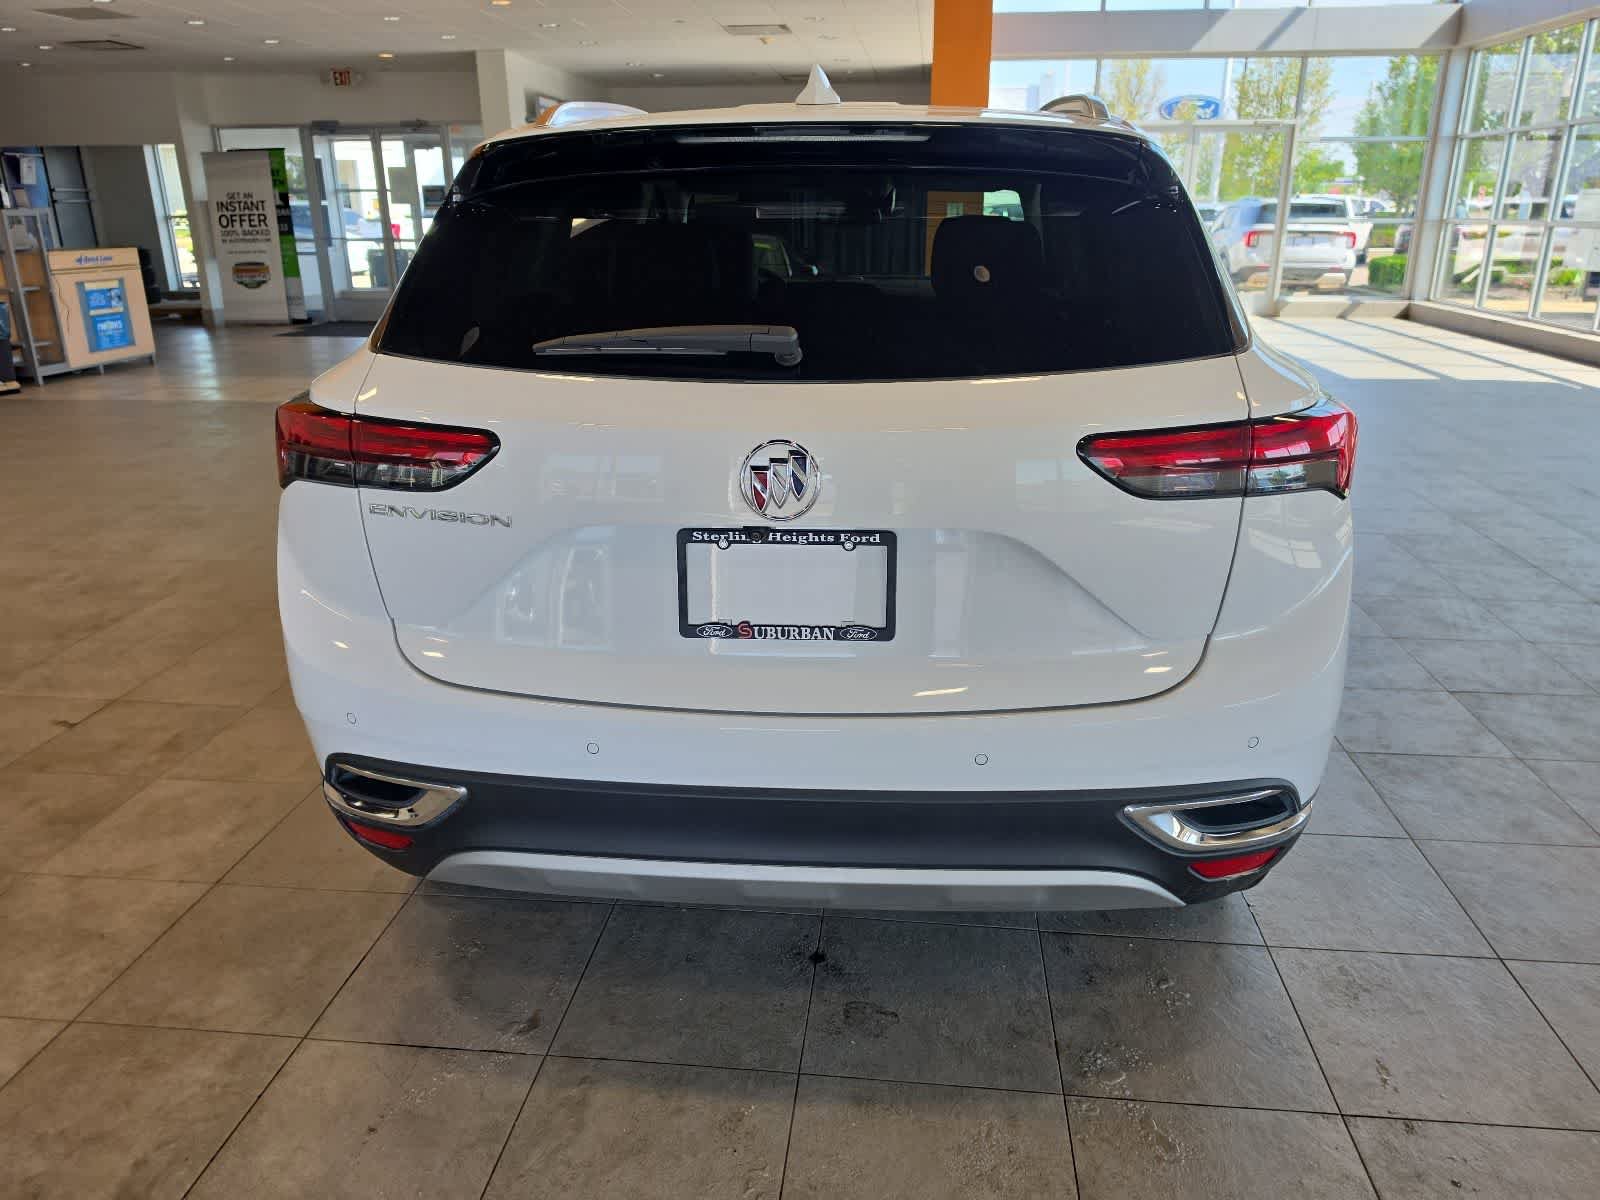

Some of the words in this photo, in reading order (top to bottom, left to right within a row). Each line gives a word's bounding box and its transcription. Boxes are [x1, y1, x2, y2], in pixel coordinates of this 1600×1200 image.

[332, 70, 351, 87] EXIT
[216, 200, 266, 213] INSTANT
[218, 213, 269, 229] OFFER
[369, 503, 512, 528] ENVISION
[767, 532, 835, 545] Heights
[839, 533, 881, 544] Ford
[701, 624, 728, 637] Ford
[737, 621, 834, 641] SUBURBAN
[845, 627, 871, 640] Ford
